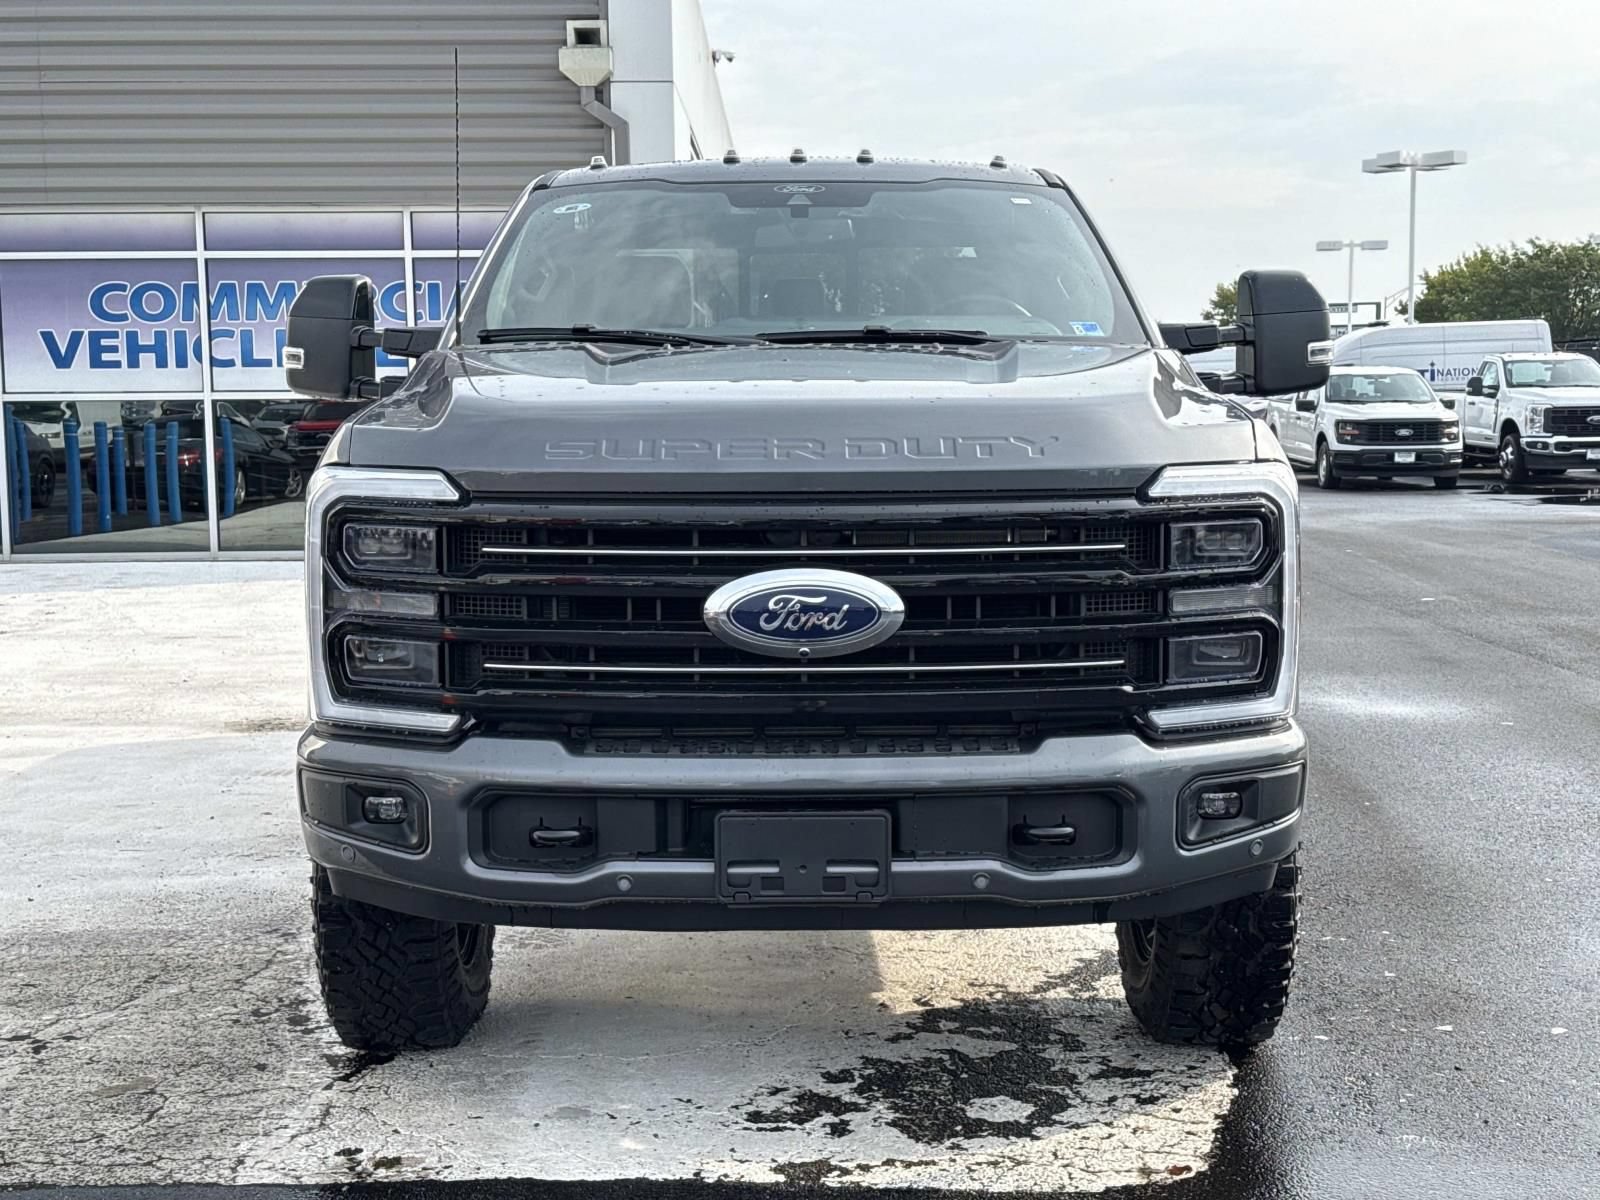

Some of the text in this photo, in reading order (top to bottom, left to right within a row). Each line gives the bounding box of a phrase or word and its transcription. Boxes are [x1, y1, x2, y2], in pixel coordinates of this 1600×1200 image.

[88, 281, 467, 324] COMMCI
[544, 436, 1059, 461] SUPER DUTY
[759, 594, 850, 632] Ford
